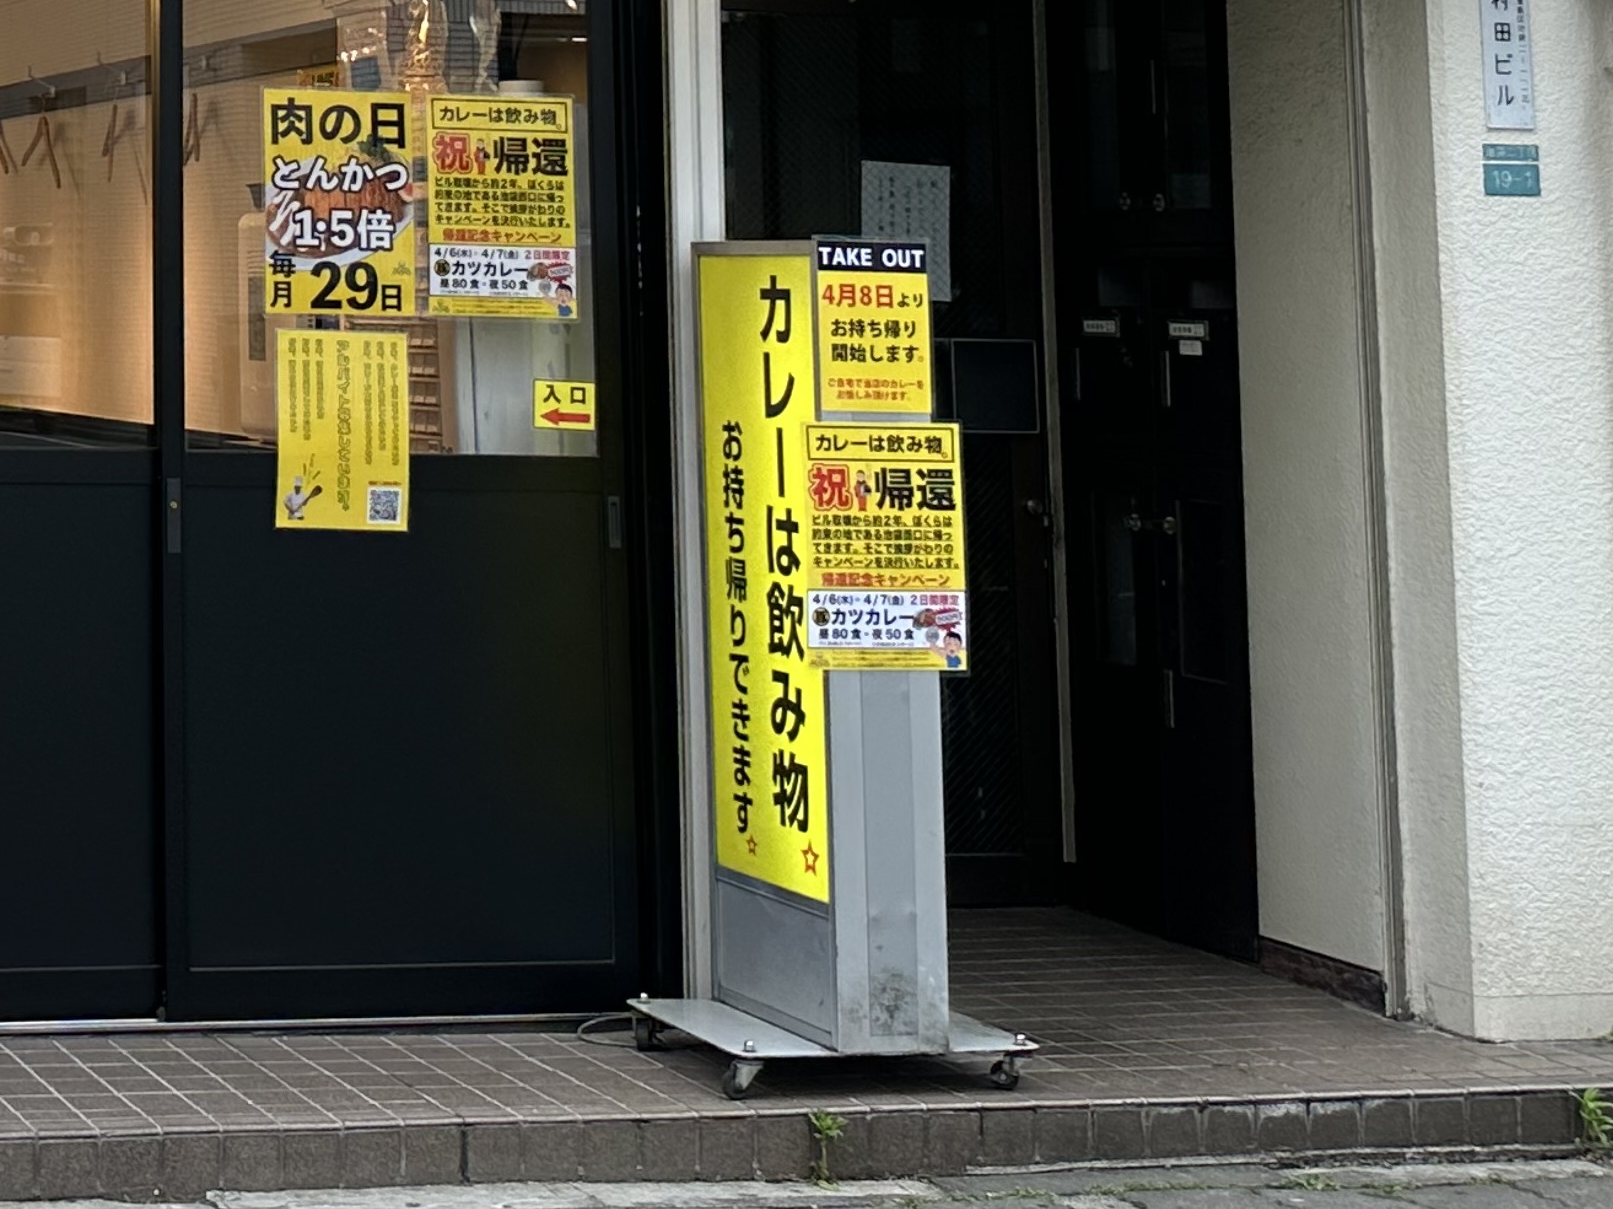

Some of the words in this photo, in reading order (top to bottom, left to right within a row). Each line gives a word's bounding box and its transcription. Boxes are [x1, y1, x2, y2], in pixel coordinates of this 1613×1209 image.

[270, 97, 406, 150] 肉の日
[433, 131, 473, 175] 祝
[493, 136, 569, 177] 帰還
[271, 155, 409, 192] とんかつ
[818, 246, 873, 267] TAKE
[881, 249, 925, 268] OUT
[268, 250, 297, 308] 毎月
[310, 261, 403, 312] 29日
[821, 283, 924, 309] 4月8日より
[830, 318, 917, 339] お持ち帰り
[831, 342, 924, 364] 開始します。
[543, 384, 587, 405] 入口
[808, 462, 854, 512] 祝
[874, 467, 957, 512] 帰還
